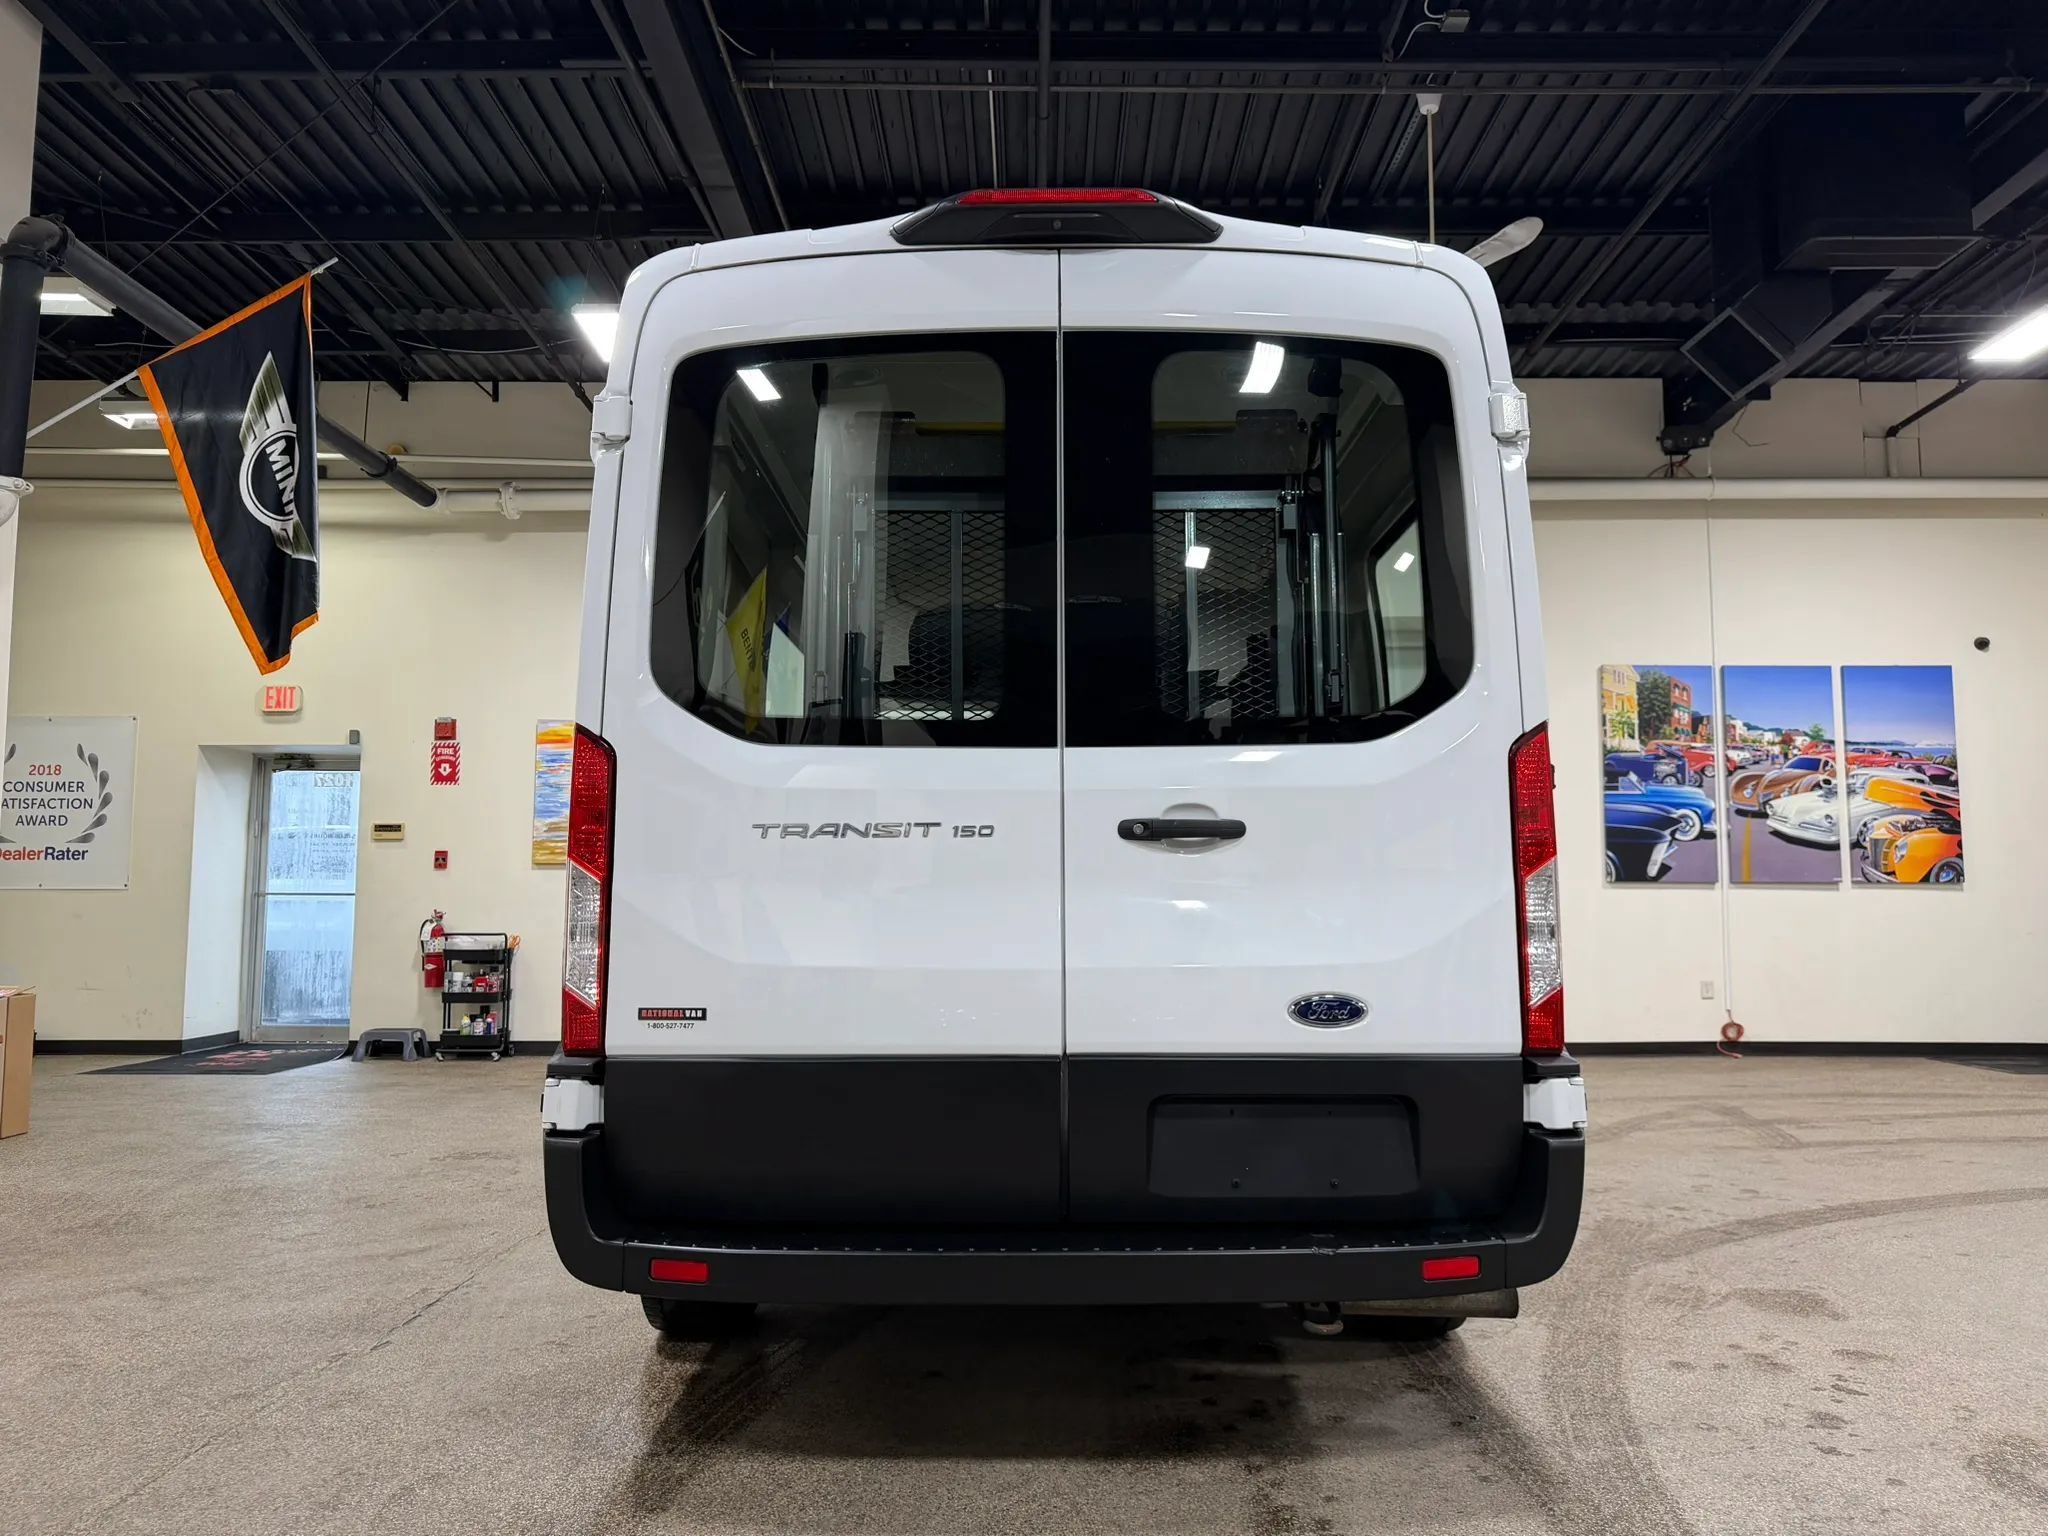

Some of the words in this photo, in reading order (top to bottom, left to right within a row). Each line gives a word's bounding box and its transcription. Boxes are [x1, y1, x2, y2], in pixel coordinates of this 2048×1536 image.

[265, 686, 296, 710] EXIT
[437, 747, 455, 755] FIRE
[28, 764, 62, 776] 2018
[3, 781, 85, 793] CONSUMER
[15, 815, 68, 826] AWARD
[752, 822, 942, 839] TRANSIT
[951, 824, 995, 838] 150
[0, 846, 88, 861] ealerRater
